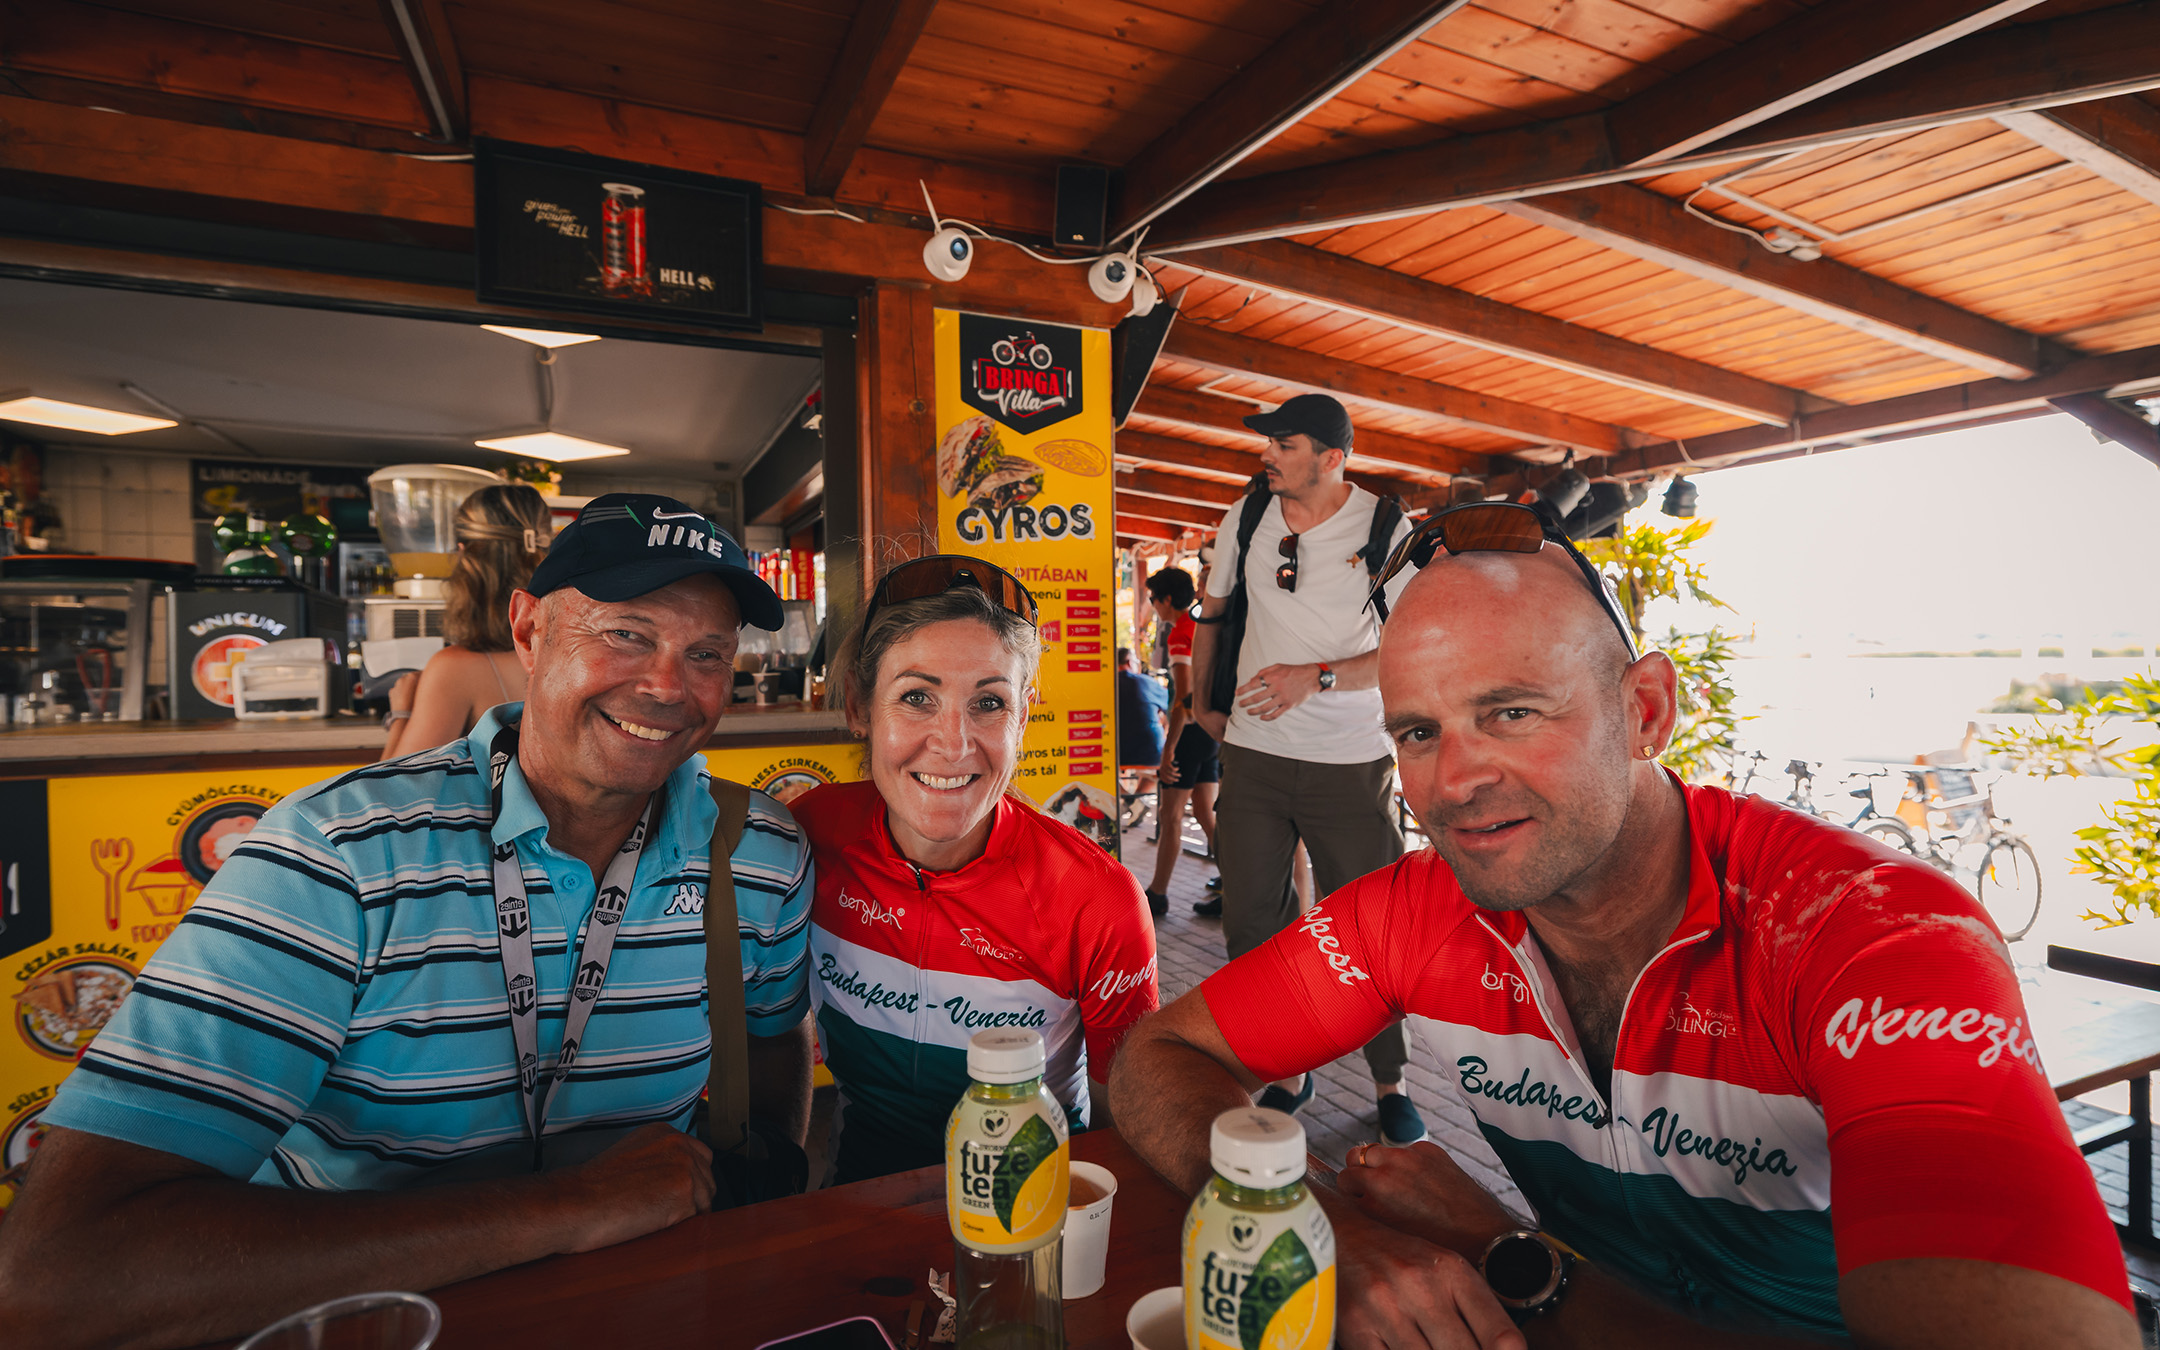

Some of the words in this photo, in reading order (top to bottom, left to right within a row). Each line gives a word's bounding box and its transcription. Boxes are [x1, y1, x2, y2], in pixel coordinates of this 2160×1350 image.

[558, 223, 589, 239] HELL
[660, 267, 696, 286] HELL
[985, 366, 1060, 396] BRINGA
[978, 388, 1067, 417] Villa
[956, 503, 1094, 543] GYROS
[647, 523, 723, 559] NIKE
[1014, 564, 1088, 582] PITÁBAN
[188, 612, 288, 636] UNICUM
[1051, 746, 1067, 757] tál
[749, 764, 777, 788] NESS
[1041, 764, 1057, 775] tál
[16, 946, 70, 982] CÉZÁR
[74, 942, 138, 963] SALÁTA
[817, 952, 920, 1015] Budapest
[943, 996, 1048, 1030] Venezia
[1825, 996, 2044, 1075] Venezia
[8, 1086, 50, 1115] SÜLT
[1456, 1055, 1602, 1124] Budapes
[1642, 1107, 1798, 1186] Venezia
[960, 1140, 1031, 1176] fuze
[960, 1171, 1011, 1199] tea
[962, 1197, 990, 1210] GREEN
[1201, 1250, 1283, 1303] fuze
[1201, 1285, 1259, 1331] tea
